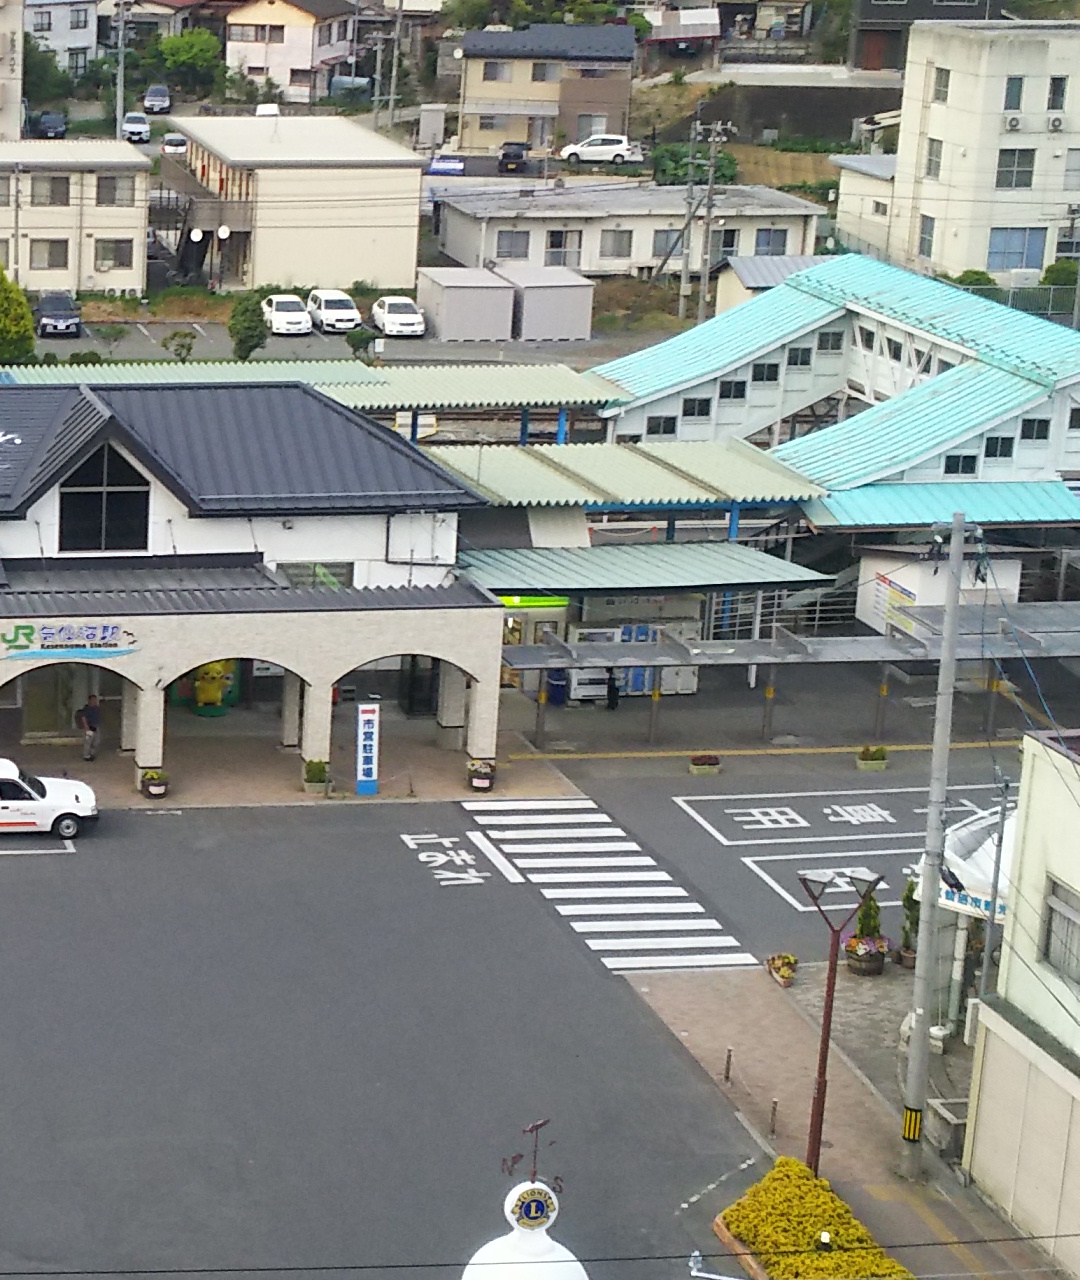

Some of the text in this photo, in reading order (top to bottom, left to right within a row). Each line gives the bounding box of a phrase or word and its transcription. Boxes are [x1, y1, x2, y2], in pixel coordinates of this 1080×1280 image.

[0, 624, 35, 644] JR
[361, 718, 376, 779] 市営駐車場
[399, 833, 493, 887] 止まれ
